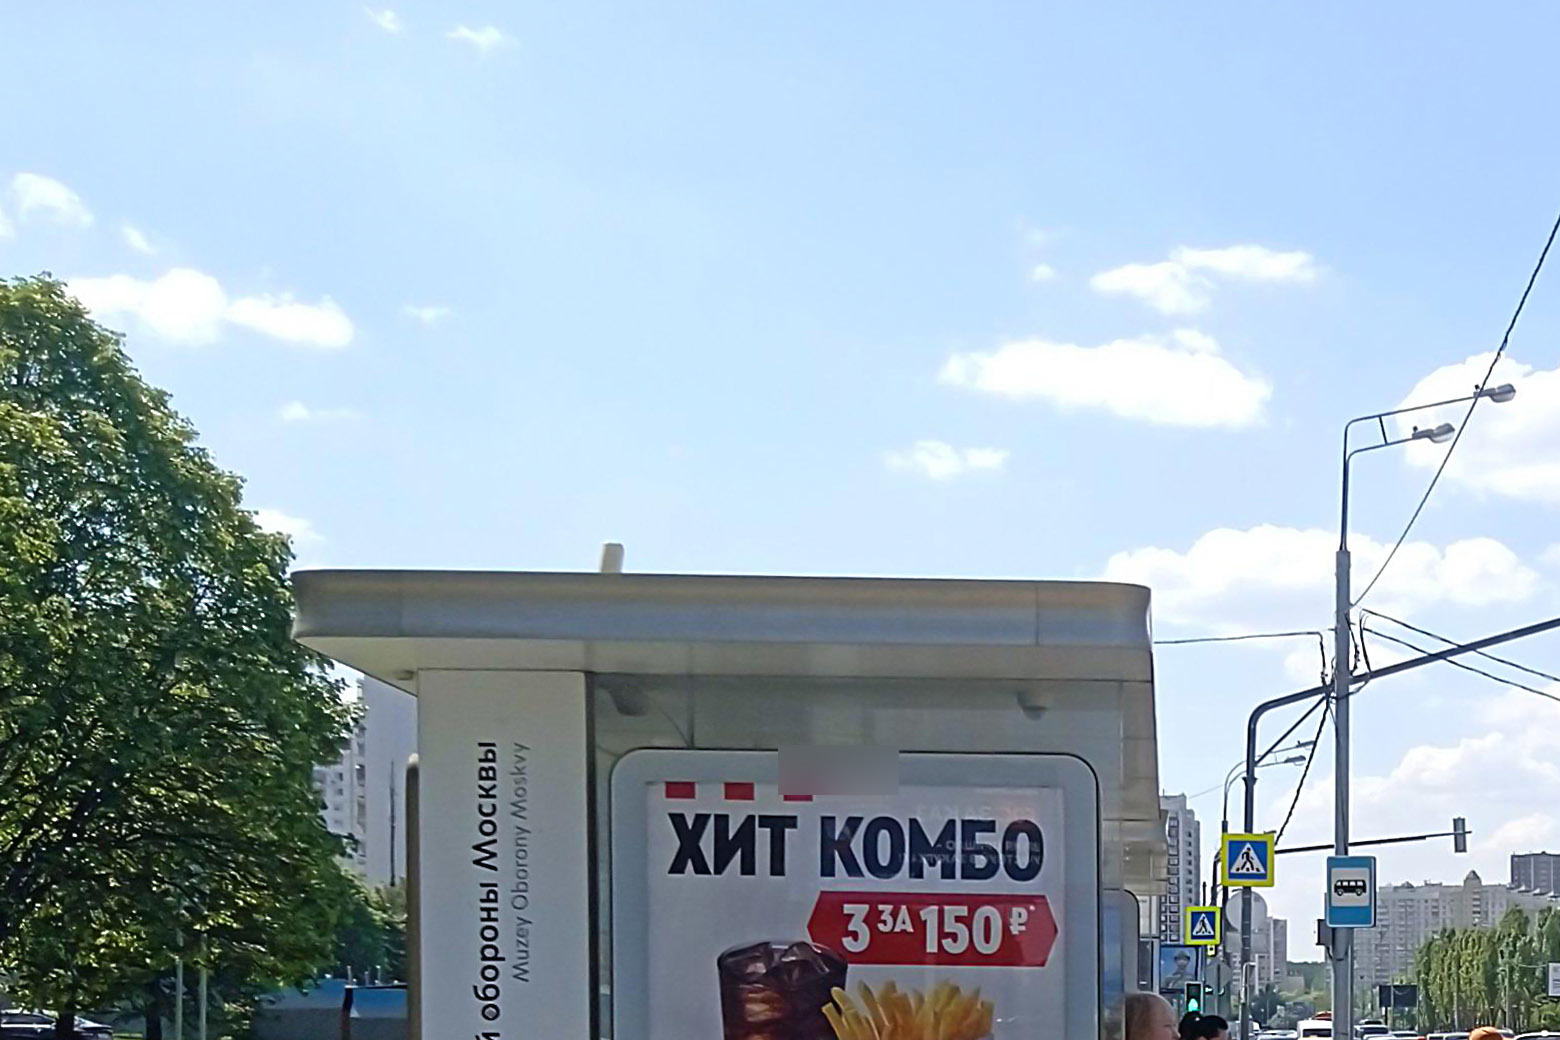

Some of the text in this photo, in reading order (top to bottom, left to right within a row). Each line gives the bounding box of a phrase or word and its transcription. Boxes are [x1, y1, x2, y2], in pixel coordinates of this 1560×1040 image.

[471, 741, 499, 872] Москвы
[508, 742, 533, 983] Muzey Oborony Moskvy
[667, 812, 1044, 882] ХИТ КОМБО
[472, 882, 506, 1022] обороны
[841, 903, 870, 953] 3
[877, 904, 914, 933] ЗА
[919, 905, 1003, 955] 150
